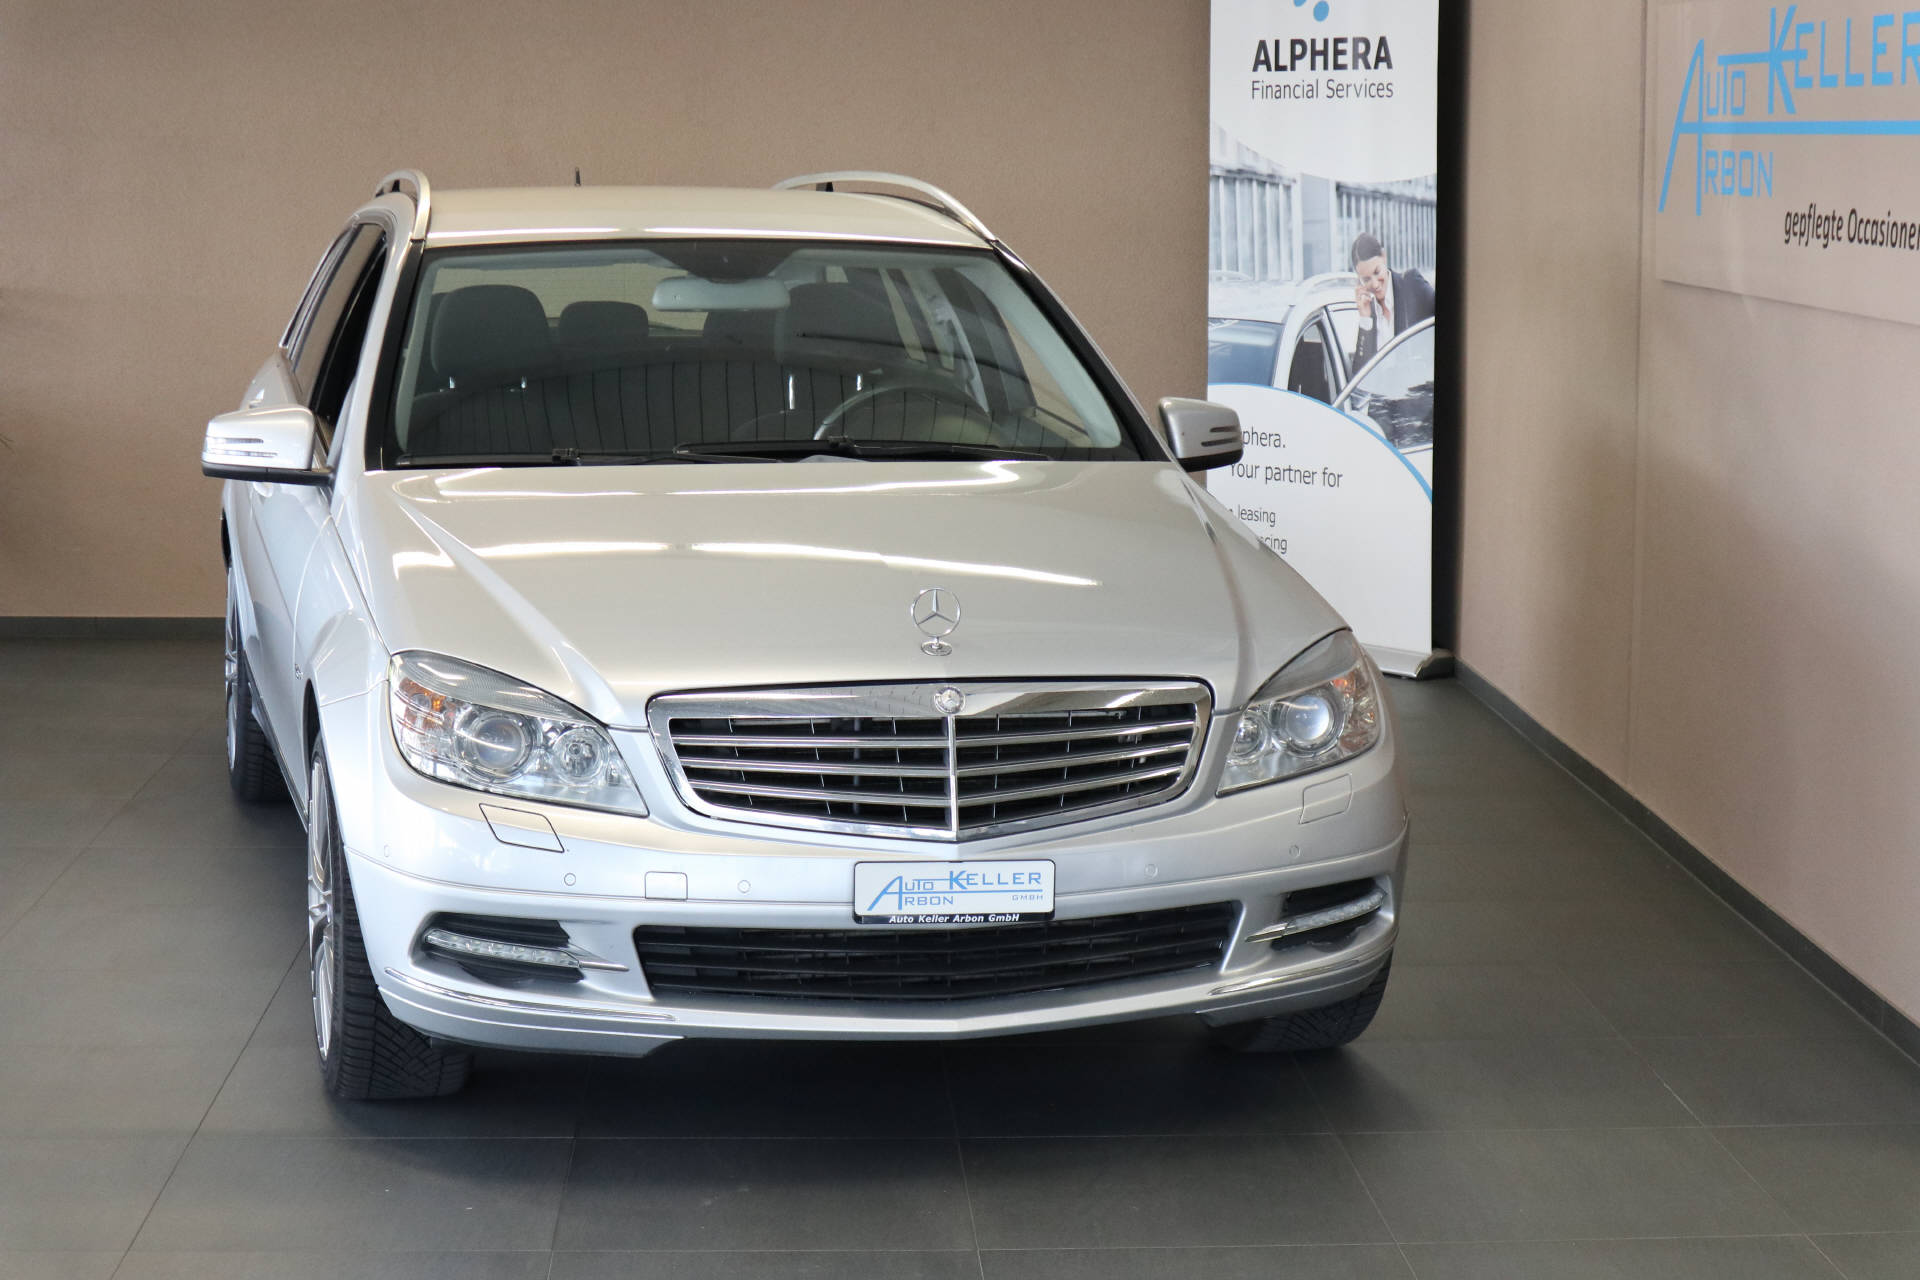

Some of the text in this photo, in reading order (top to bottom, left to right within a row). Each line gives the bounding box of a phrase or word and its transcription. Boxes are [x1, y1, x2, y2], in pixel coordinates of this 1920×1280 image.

[1252, 36, 1393, 72] ALPHERA
[1251, 78, 1394, 100] Financial Services
[1784, 203, 1843, 248] gepflegte
[1242, 426, 1286, 448] phera.
[1230, 463, 1343, 488] Your partner for
[1237, 504, 1276, 528] leasing
[889, 913, 1020, 924] Auto Keller Arbon GmbH
